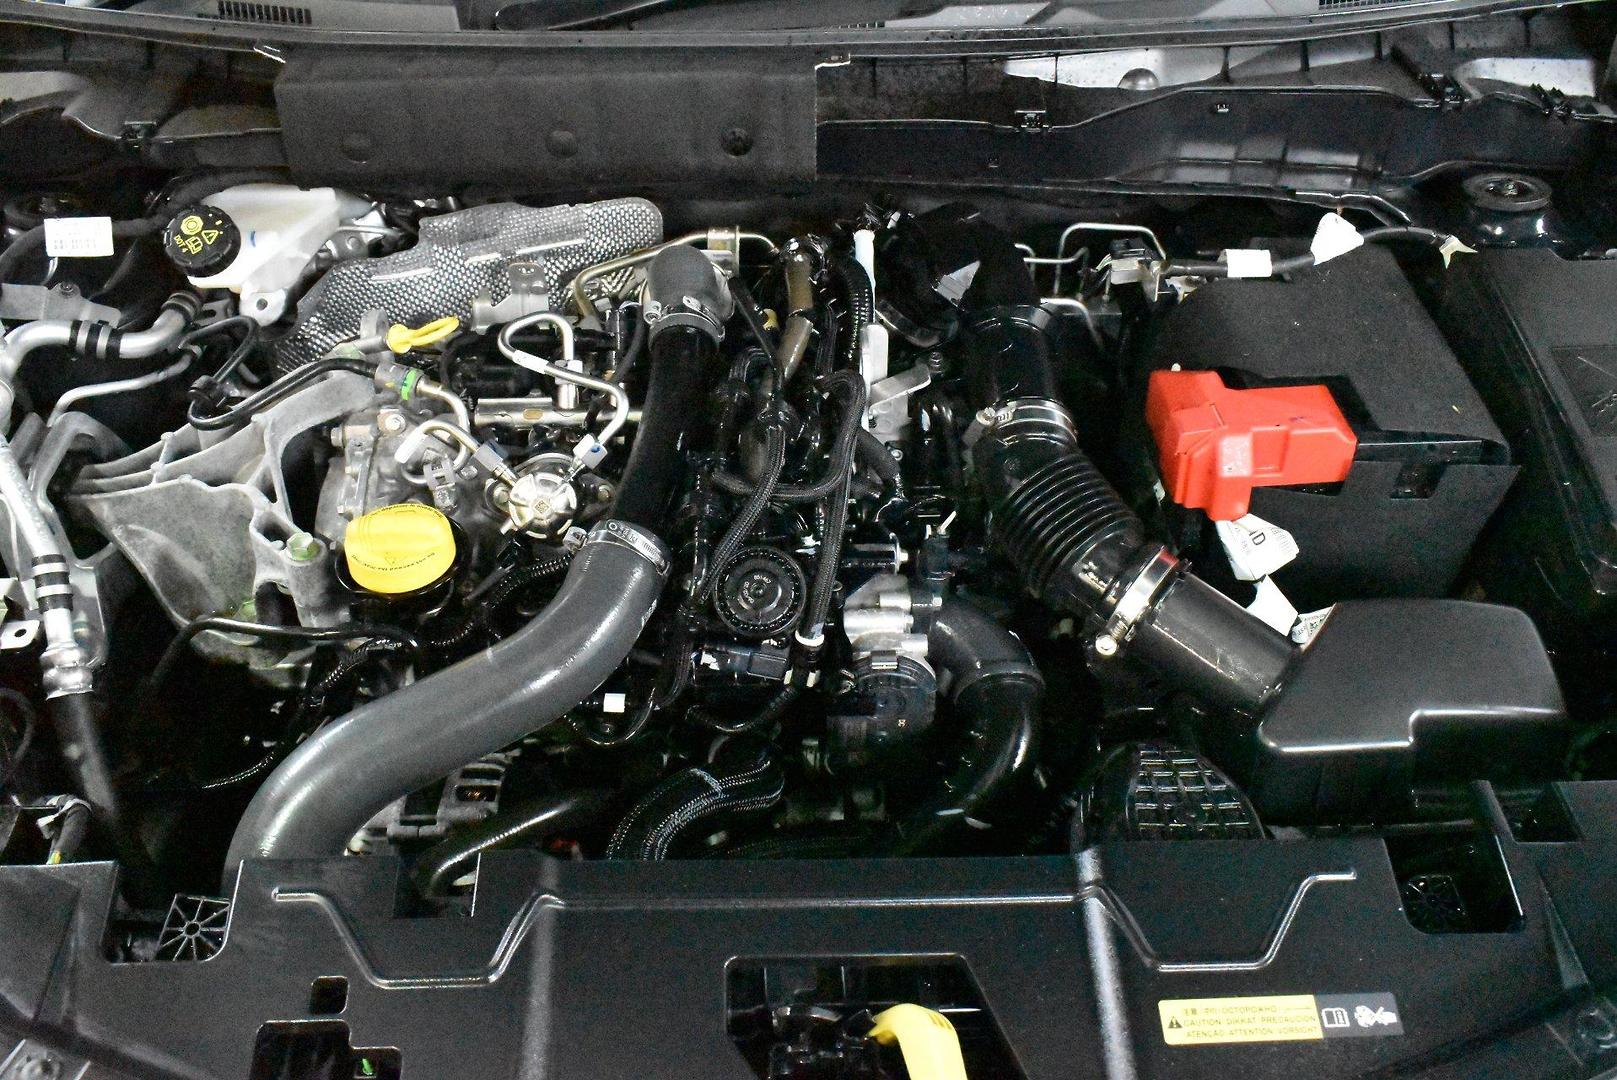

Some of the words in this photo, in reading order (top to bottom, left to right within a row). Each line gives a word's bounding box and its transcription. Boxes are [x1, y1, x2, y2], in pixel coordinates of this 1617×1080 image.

[174, 234, 186, 247] DOT
[1183, 1018, 1222, 1027] CAUTION
[1229, 1027, 1274, 1036] ATTENTION
